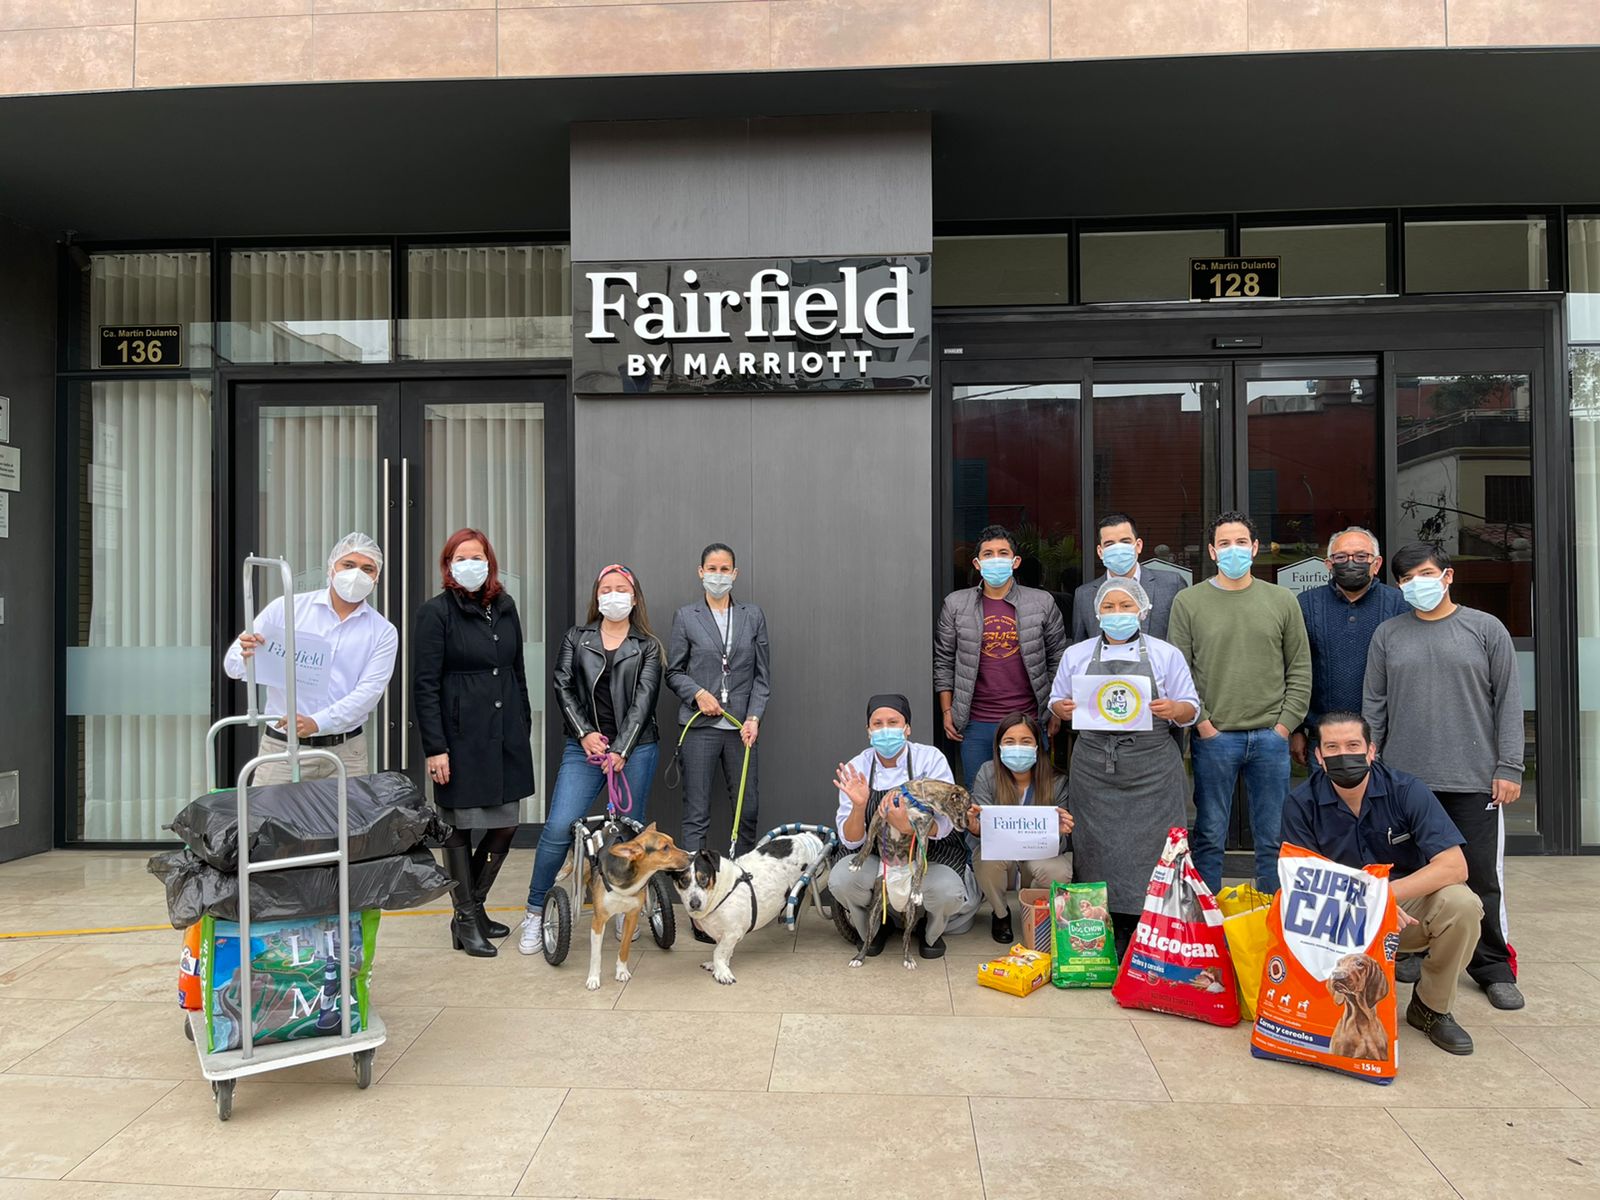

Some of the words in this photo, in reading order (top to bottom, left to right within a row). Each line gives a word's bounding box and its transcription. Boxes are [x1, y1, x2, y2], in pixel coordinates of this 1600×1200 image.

[1194, 262, 1208, 270] Ca.
[1241, 261, 1276, 270] Dulanto
[1210, 273, 1260, 297] 128
[584, 266, 915, 340] Fairfield
[145, 329, 178, 337] Dulanto
[117, 340, 162, 363] 136
[627, 353, 668, 377] BY
[684, 350, 873, 377] MARRIOTT
[1292, 571, 1331, 582] Fairfiel
[268, 641, 324, 666] Faifield
[993, 816, 1047, 830] Fairfield
[1284, 889, 1368, 947] CAN
[1135, 921, 1220, 958] Ricocan
[1259, 1017, 1275, 1031] Carne
[1275, 1025, 1281, 1034] y
[1281, 1026, 1313, 1042] cereales
